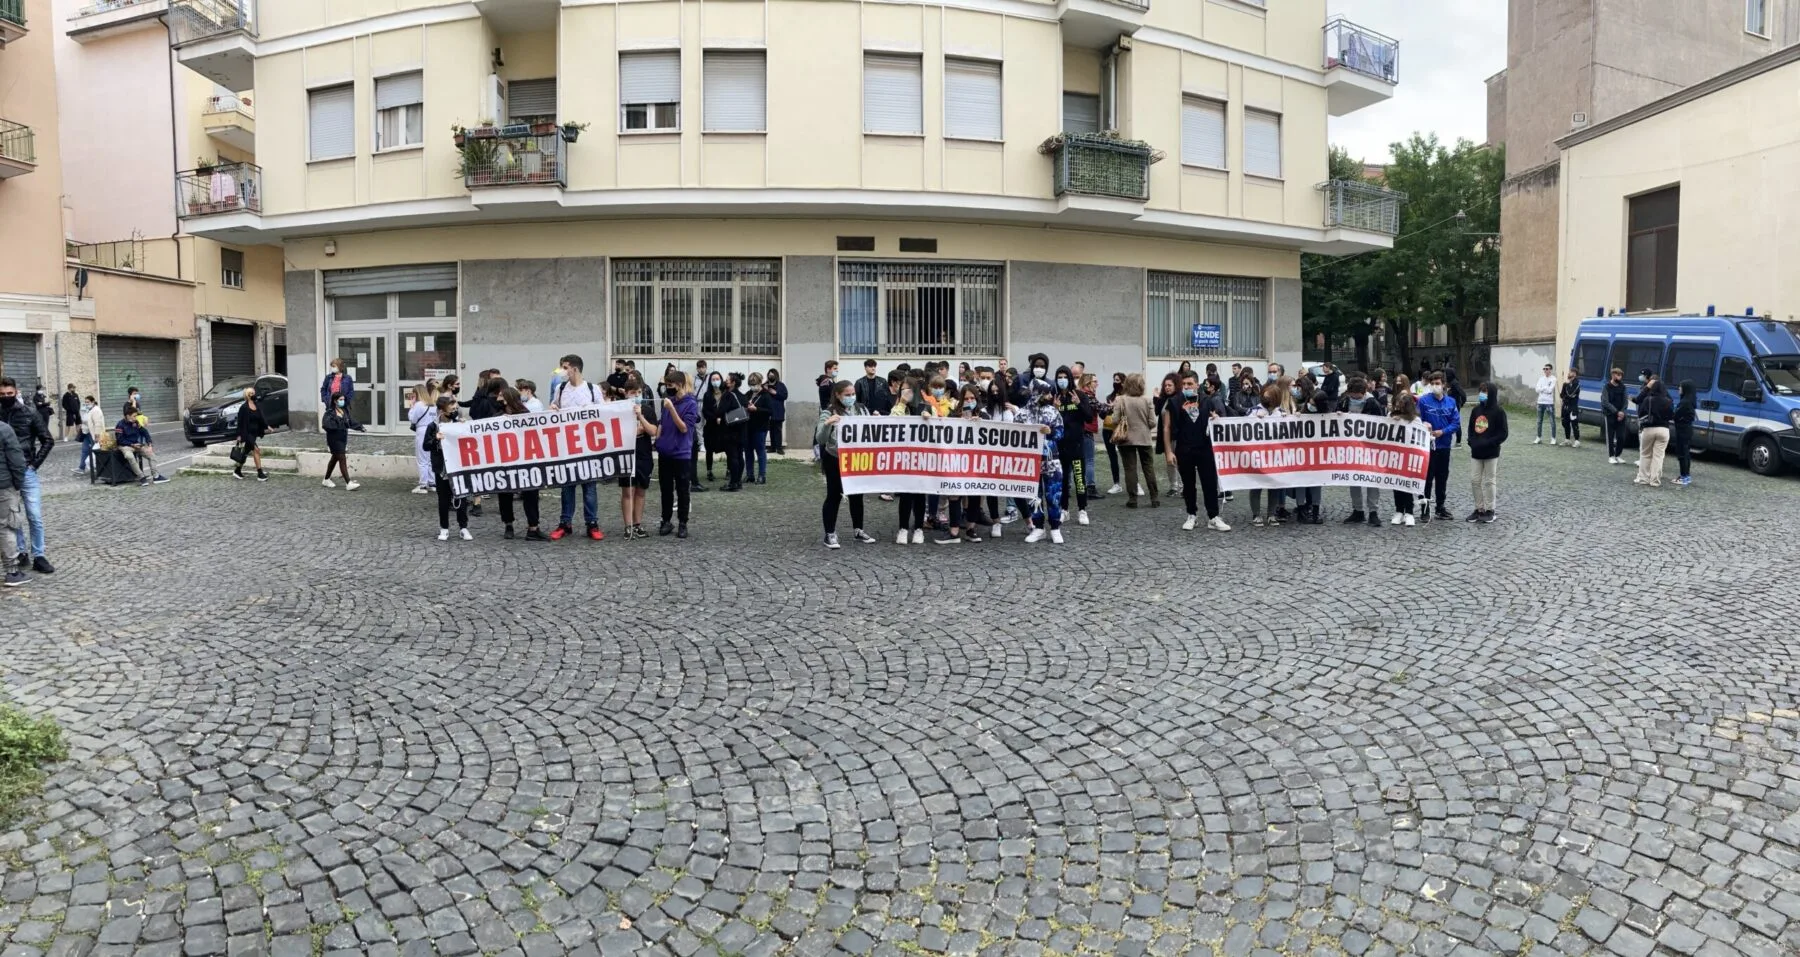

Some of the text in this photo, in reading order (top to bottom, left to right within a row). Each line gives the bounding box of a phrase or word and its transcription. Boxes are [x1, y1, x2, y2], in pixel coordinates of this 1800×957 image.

[1194, 330, 1220, 338] VENDE
[470, 409, 600, 434] IPIAS ORAZIO OLIVIERI
[1213, 419, 1426, 447] RIVOGLIAMO LA SCUOLA !!!
[458, 418, 622, 467] RIDATECI
[842, 424, 1038, 449] CI AVETE TOLTO LA SCUOLA
[841, 452, 1035, 477] E NOI CI PRENDIAMO LA PIAZZA
[1215, 446, 1424, 473] RIVOGLIAMO I LABORATORI !!!
[453, 474, 468, 496] IL
[471, 466, 542, 492] NOSTRO
[545, 456, 614, 485] FUTURO
[964, 482, 996, 491] ORAZIO
[998, 483, 1035, 493] OLIVIERI
[1331, 473, 1420, 489] IPIAS ORAZIO OLIVIERI
